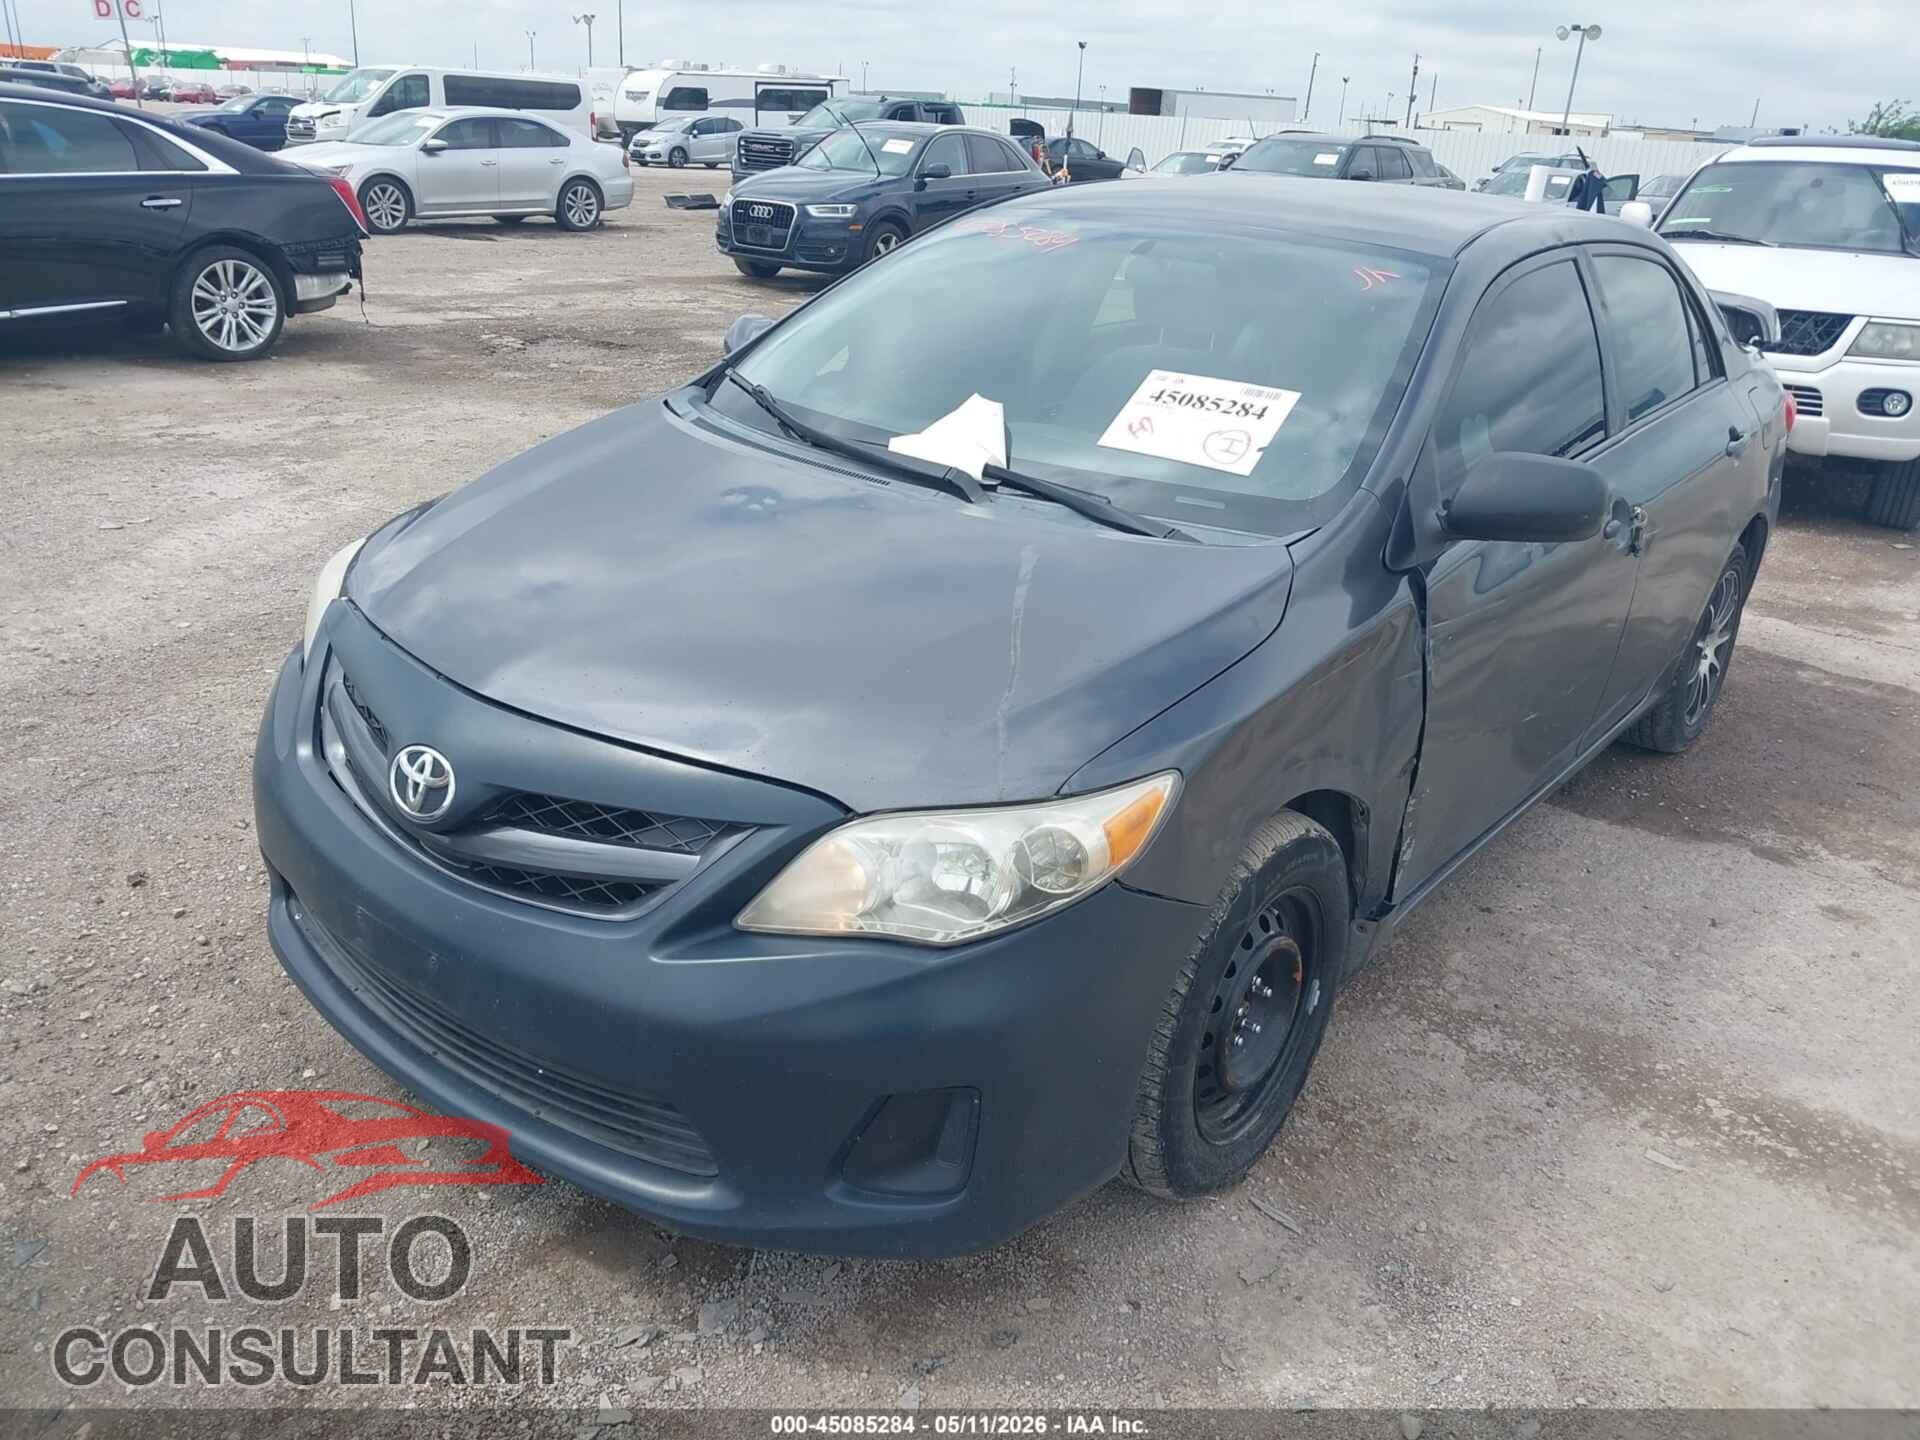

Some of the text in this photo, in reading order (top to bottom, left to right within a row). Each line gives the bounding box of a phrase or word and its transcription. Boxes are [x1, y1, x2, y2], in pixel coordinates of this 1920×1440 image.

[95, 0, 111, 17] D
[125, 0, 141, 17] C
[1149, 388, 1269, 421] 45085284
